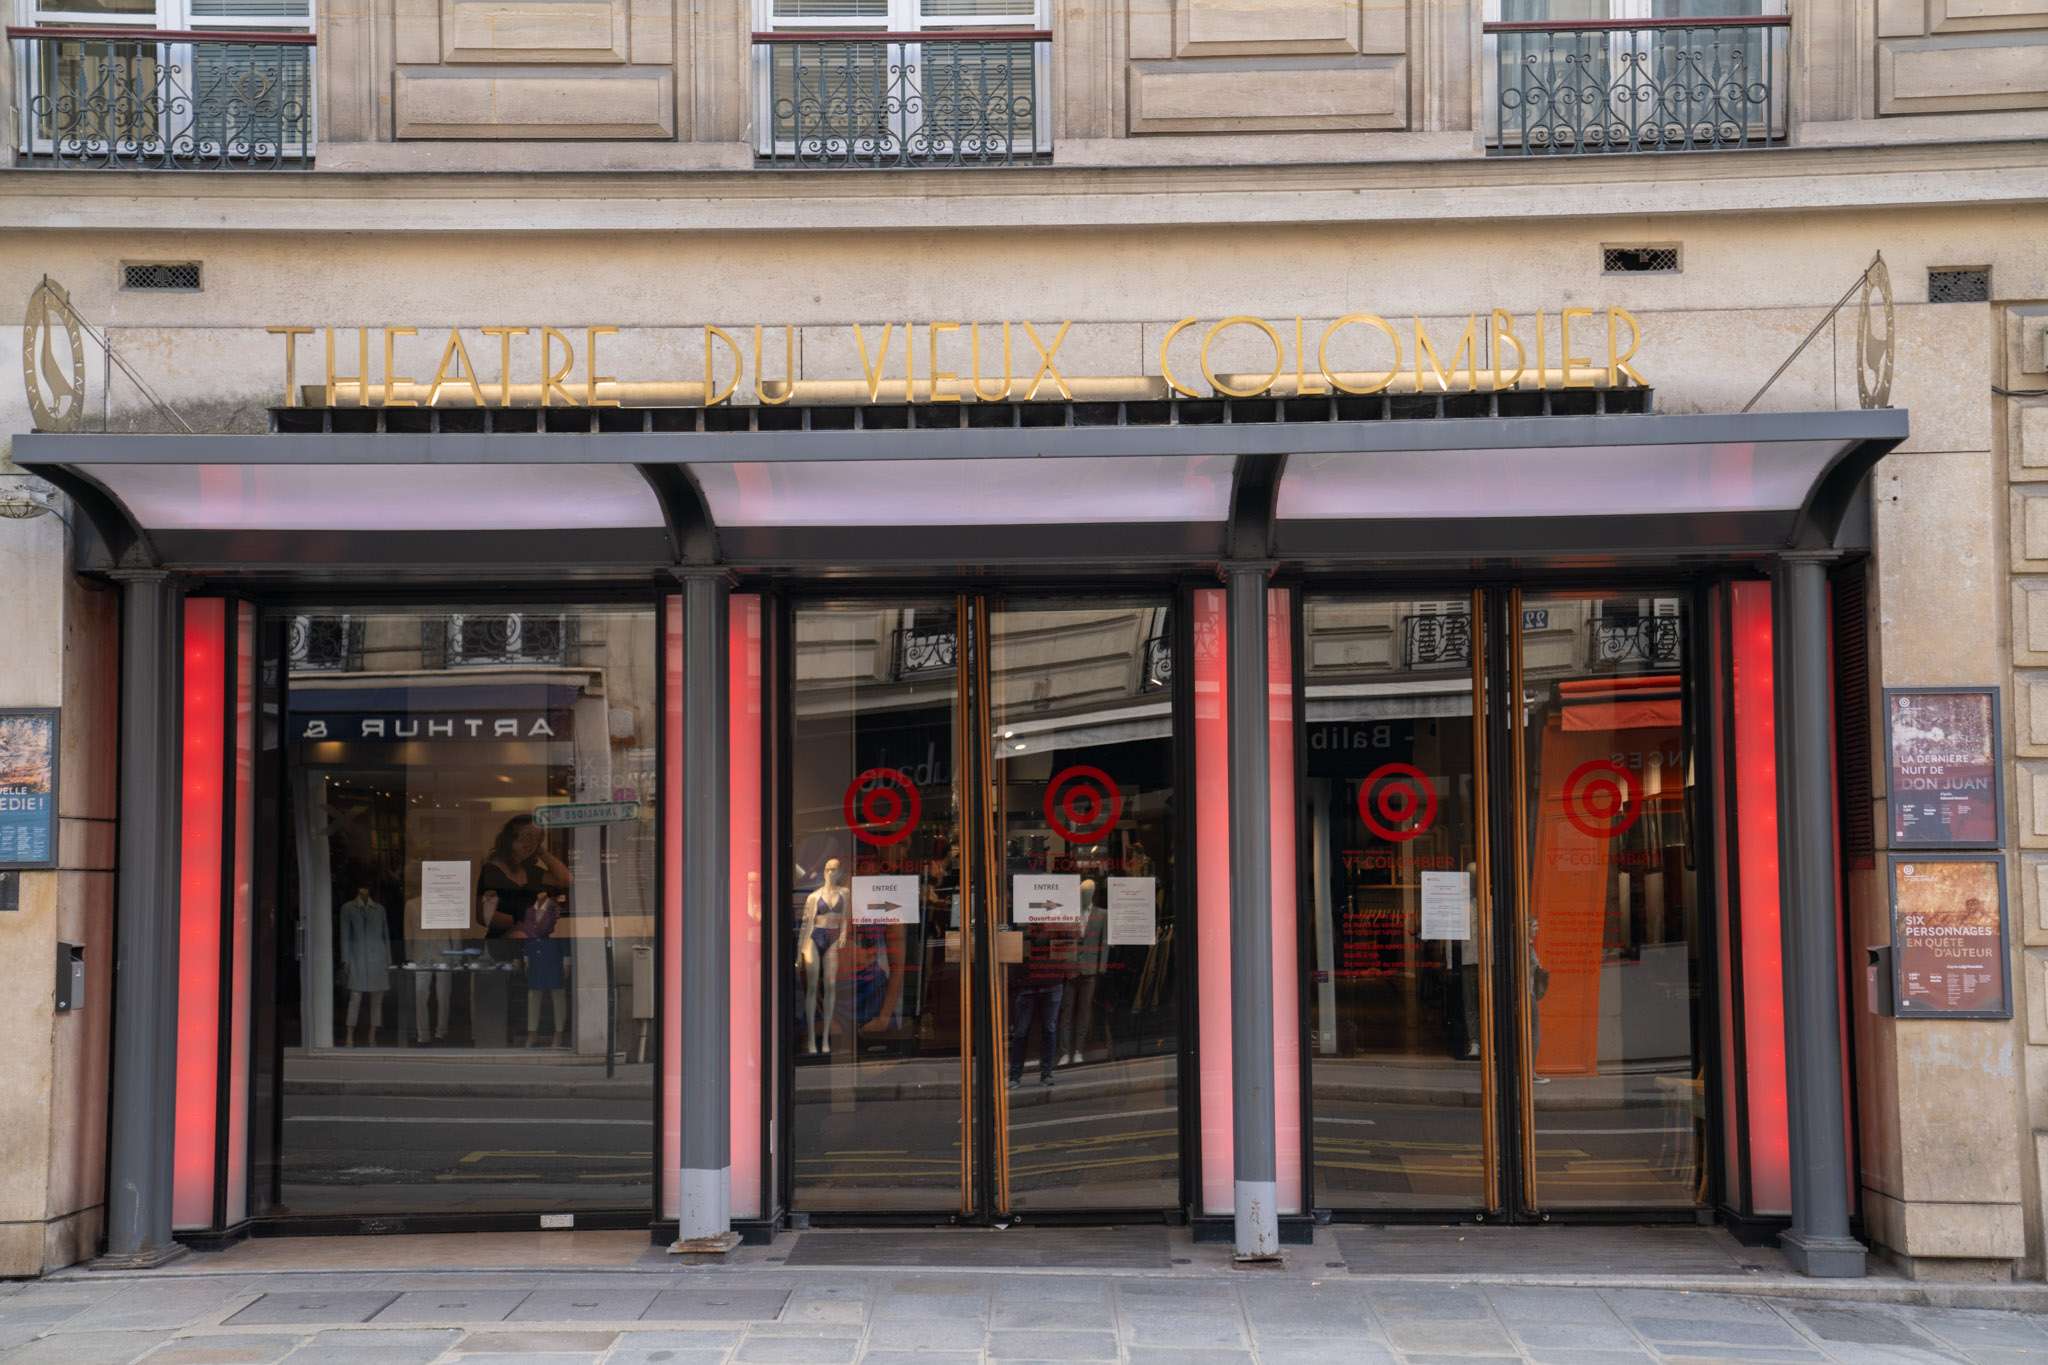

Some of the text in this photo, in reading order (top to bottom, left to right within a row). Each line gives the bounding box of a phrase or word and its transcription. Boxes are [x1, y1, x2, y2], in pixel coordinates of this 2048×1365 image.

[265, 304, 1650, 407] THEATRE DU VIEUX COLOMBIER
[1901, 755, 1914, 763] LA
[1901, 766, 1944, 775] NUIT DE
[1902, 777, 1988, 790] DON JUAN
[871, 883, 898, 892] ENTRÉE
[1033, 882, 1060, 891] ENTRÉE
[1905, 915, 1925, 926] SIX
[1906, 926, 1993, 936] PERSONNAGES
[1907, 938, 1922, 948] EN
[1935, 948, 1993, 958] D'AUTEUR
